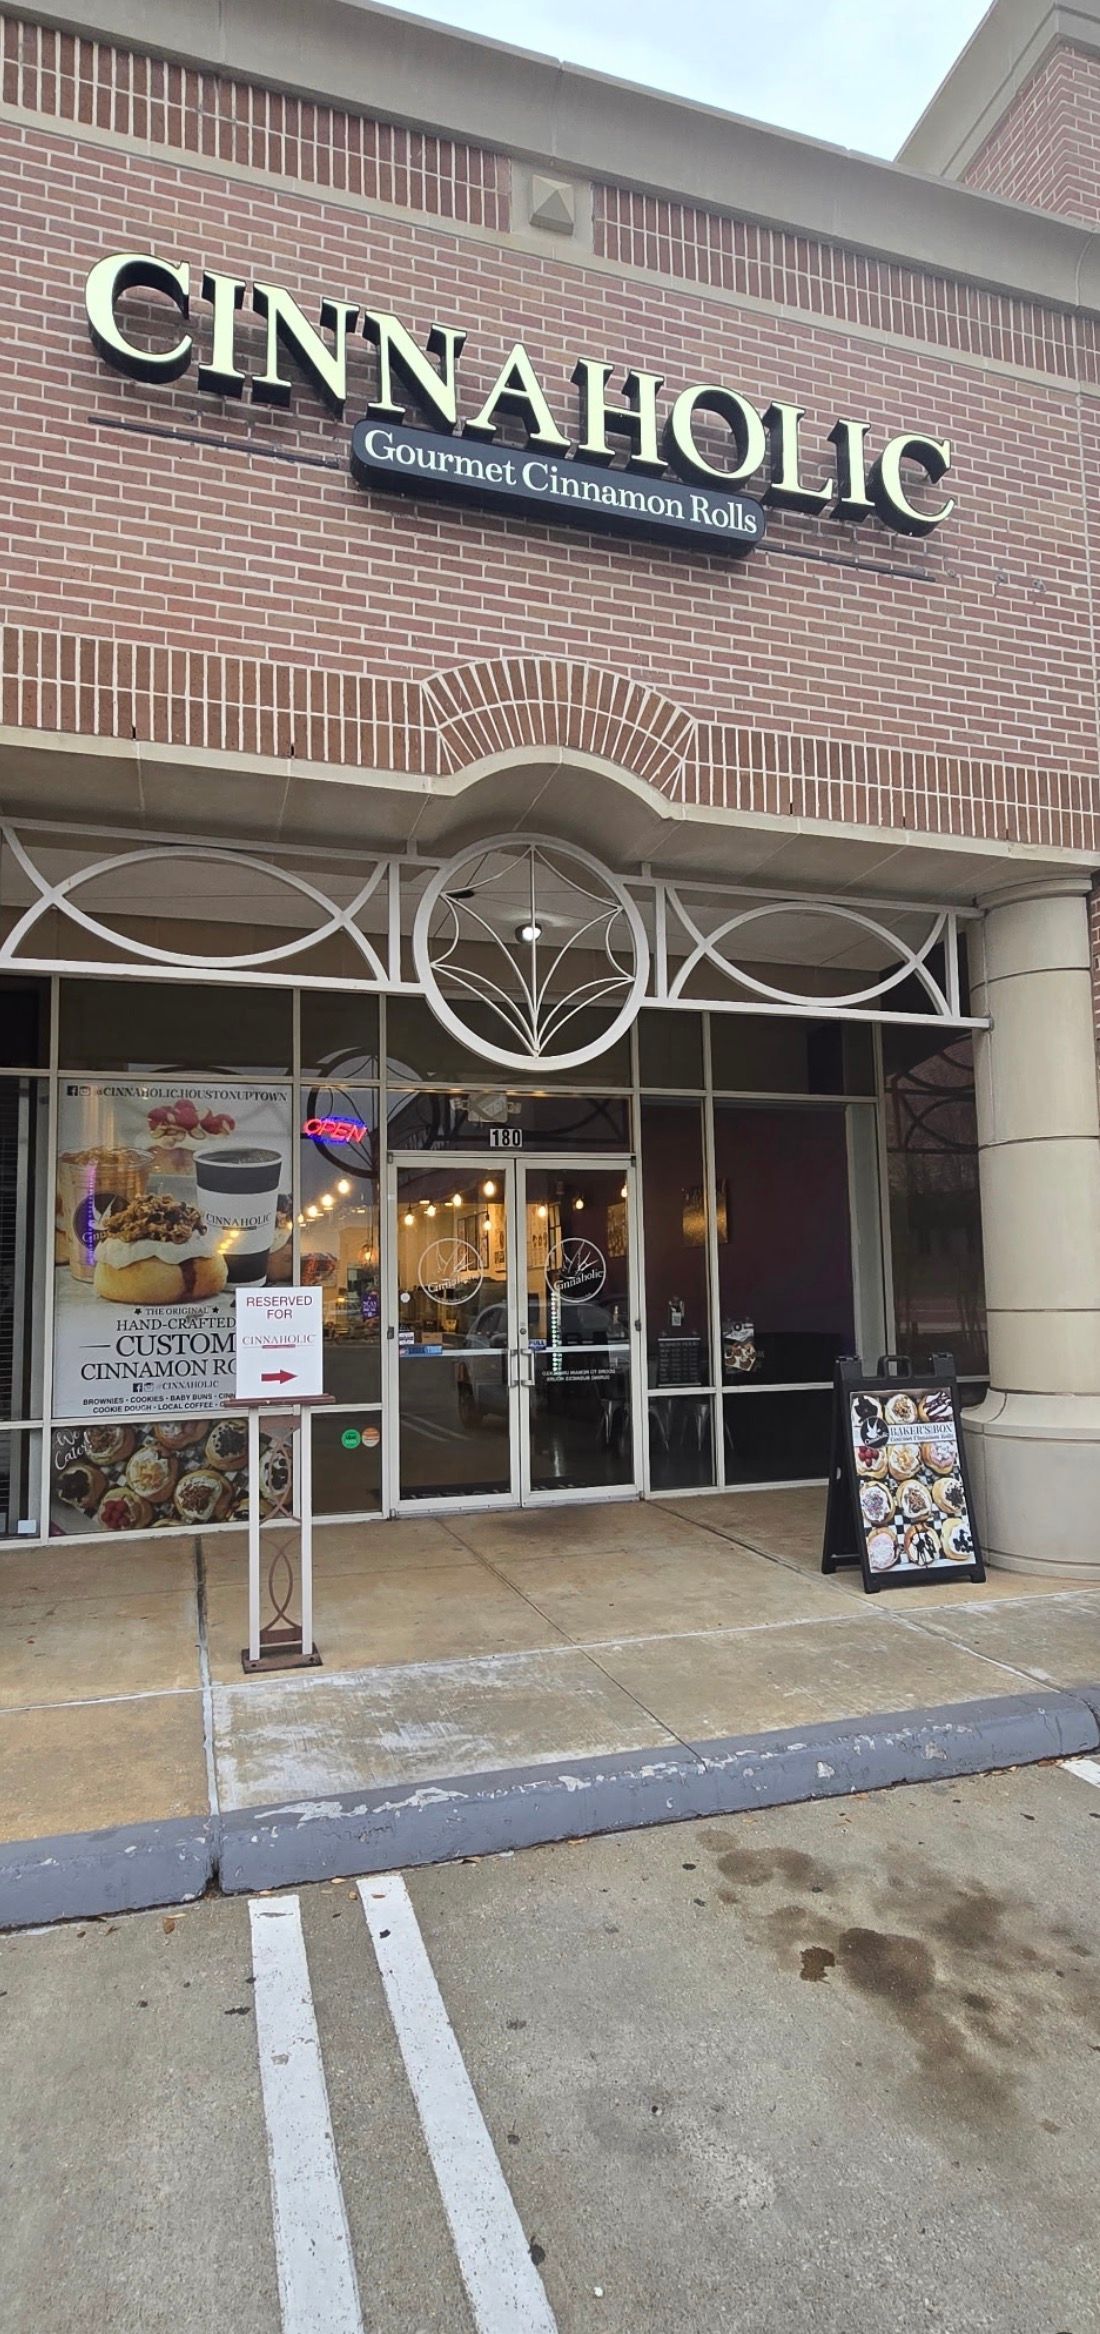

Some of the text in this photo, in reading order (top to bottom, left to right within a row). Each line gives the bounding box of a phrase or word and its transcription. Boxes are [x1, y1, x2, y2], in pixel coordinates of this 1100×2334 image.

[84, 251, 957, 534] CINNAHOLIC
[364, 428, 758, 535] Gourmet Cinnamon Rolls
[303, 1118, 368, 1143] OPEN
[492, 1129, 521, 1146] 180
[206, 1212, 272, 1227] CINNAHOLIC
[246, 1296, 313, 1307] RESERVED
[146, 1307, 208, 1316] THE ORIGINAL
[267, 1309, 293, 1320] FOR
[116, 1317, 236, 1332] HAND-CRAFTED
[116, 1332, 236, 1357] CUSTOM
[242, 1334, 315, 1345] CINNAHOLIC
[81, 1359, 209, 1381] CINNAMON
[83, 1397, 125, 1406] BROWNIES
[130, 1394, 165, 1404] COOKIES
[170, 1394, 191, 1402] BABY
[192, 1392, 213, 1400] BUNS
[93, 1406, 123, 1414] COOKIE
[124, 1404, 152, 1412] DOUGH
[157, 1403, 183, 1411] LOCAL
[184, 1401, 214, 1409] COFFEE
[933, 1423, 953, 1433] BOX
